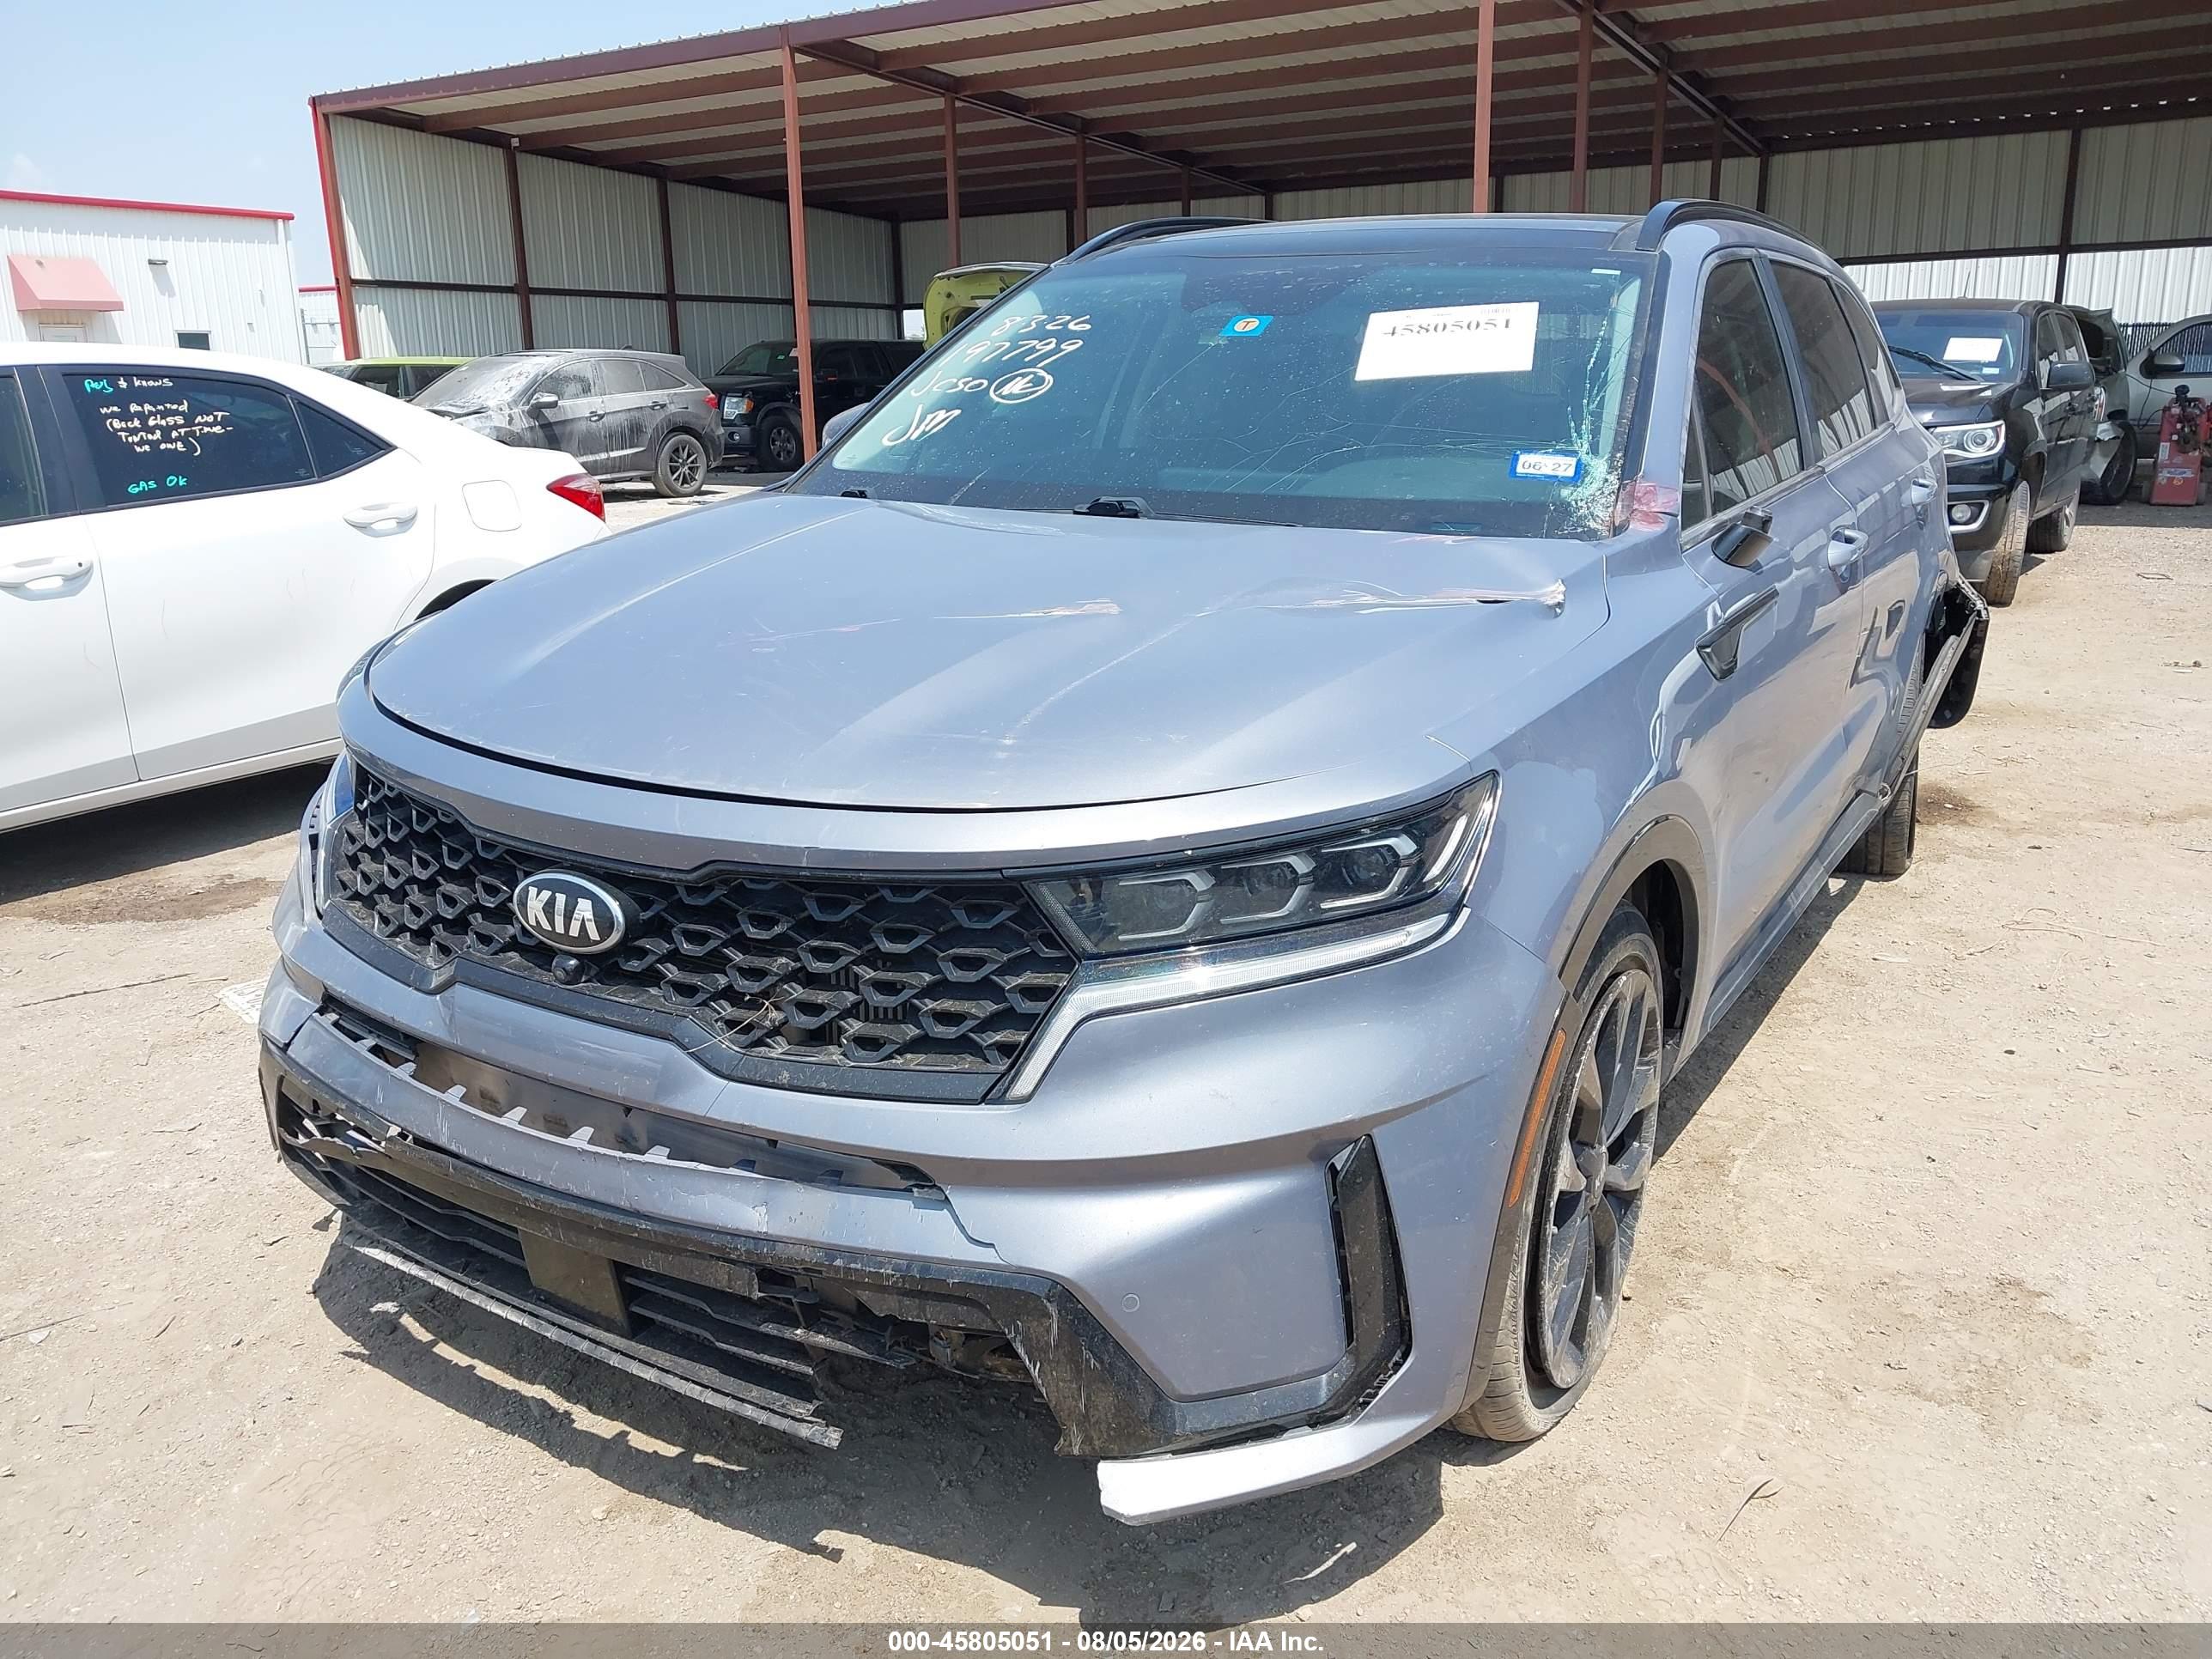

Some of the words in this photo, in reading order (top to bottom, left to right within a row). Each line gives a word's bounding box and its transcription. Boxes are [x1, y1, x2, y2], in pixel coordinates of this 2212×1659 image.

[992, 314, 1092, 337] 8326
[1243, 320, 1257, 331] T
[1383, 319, 1510, 337] 45805051
[127, 480, 158, 494] GAS
[166, 475, 188, 487] OK
